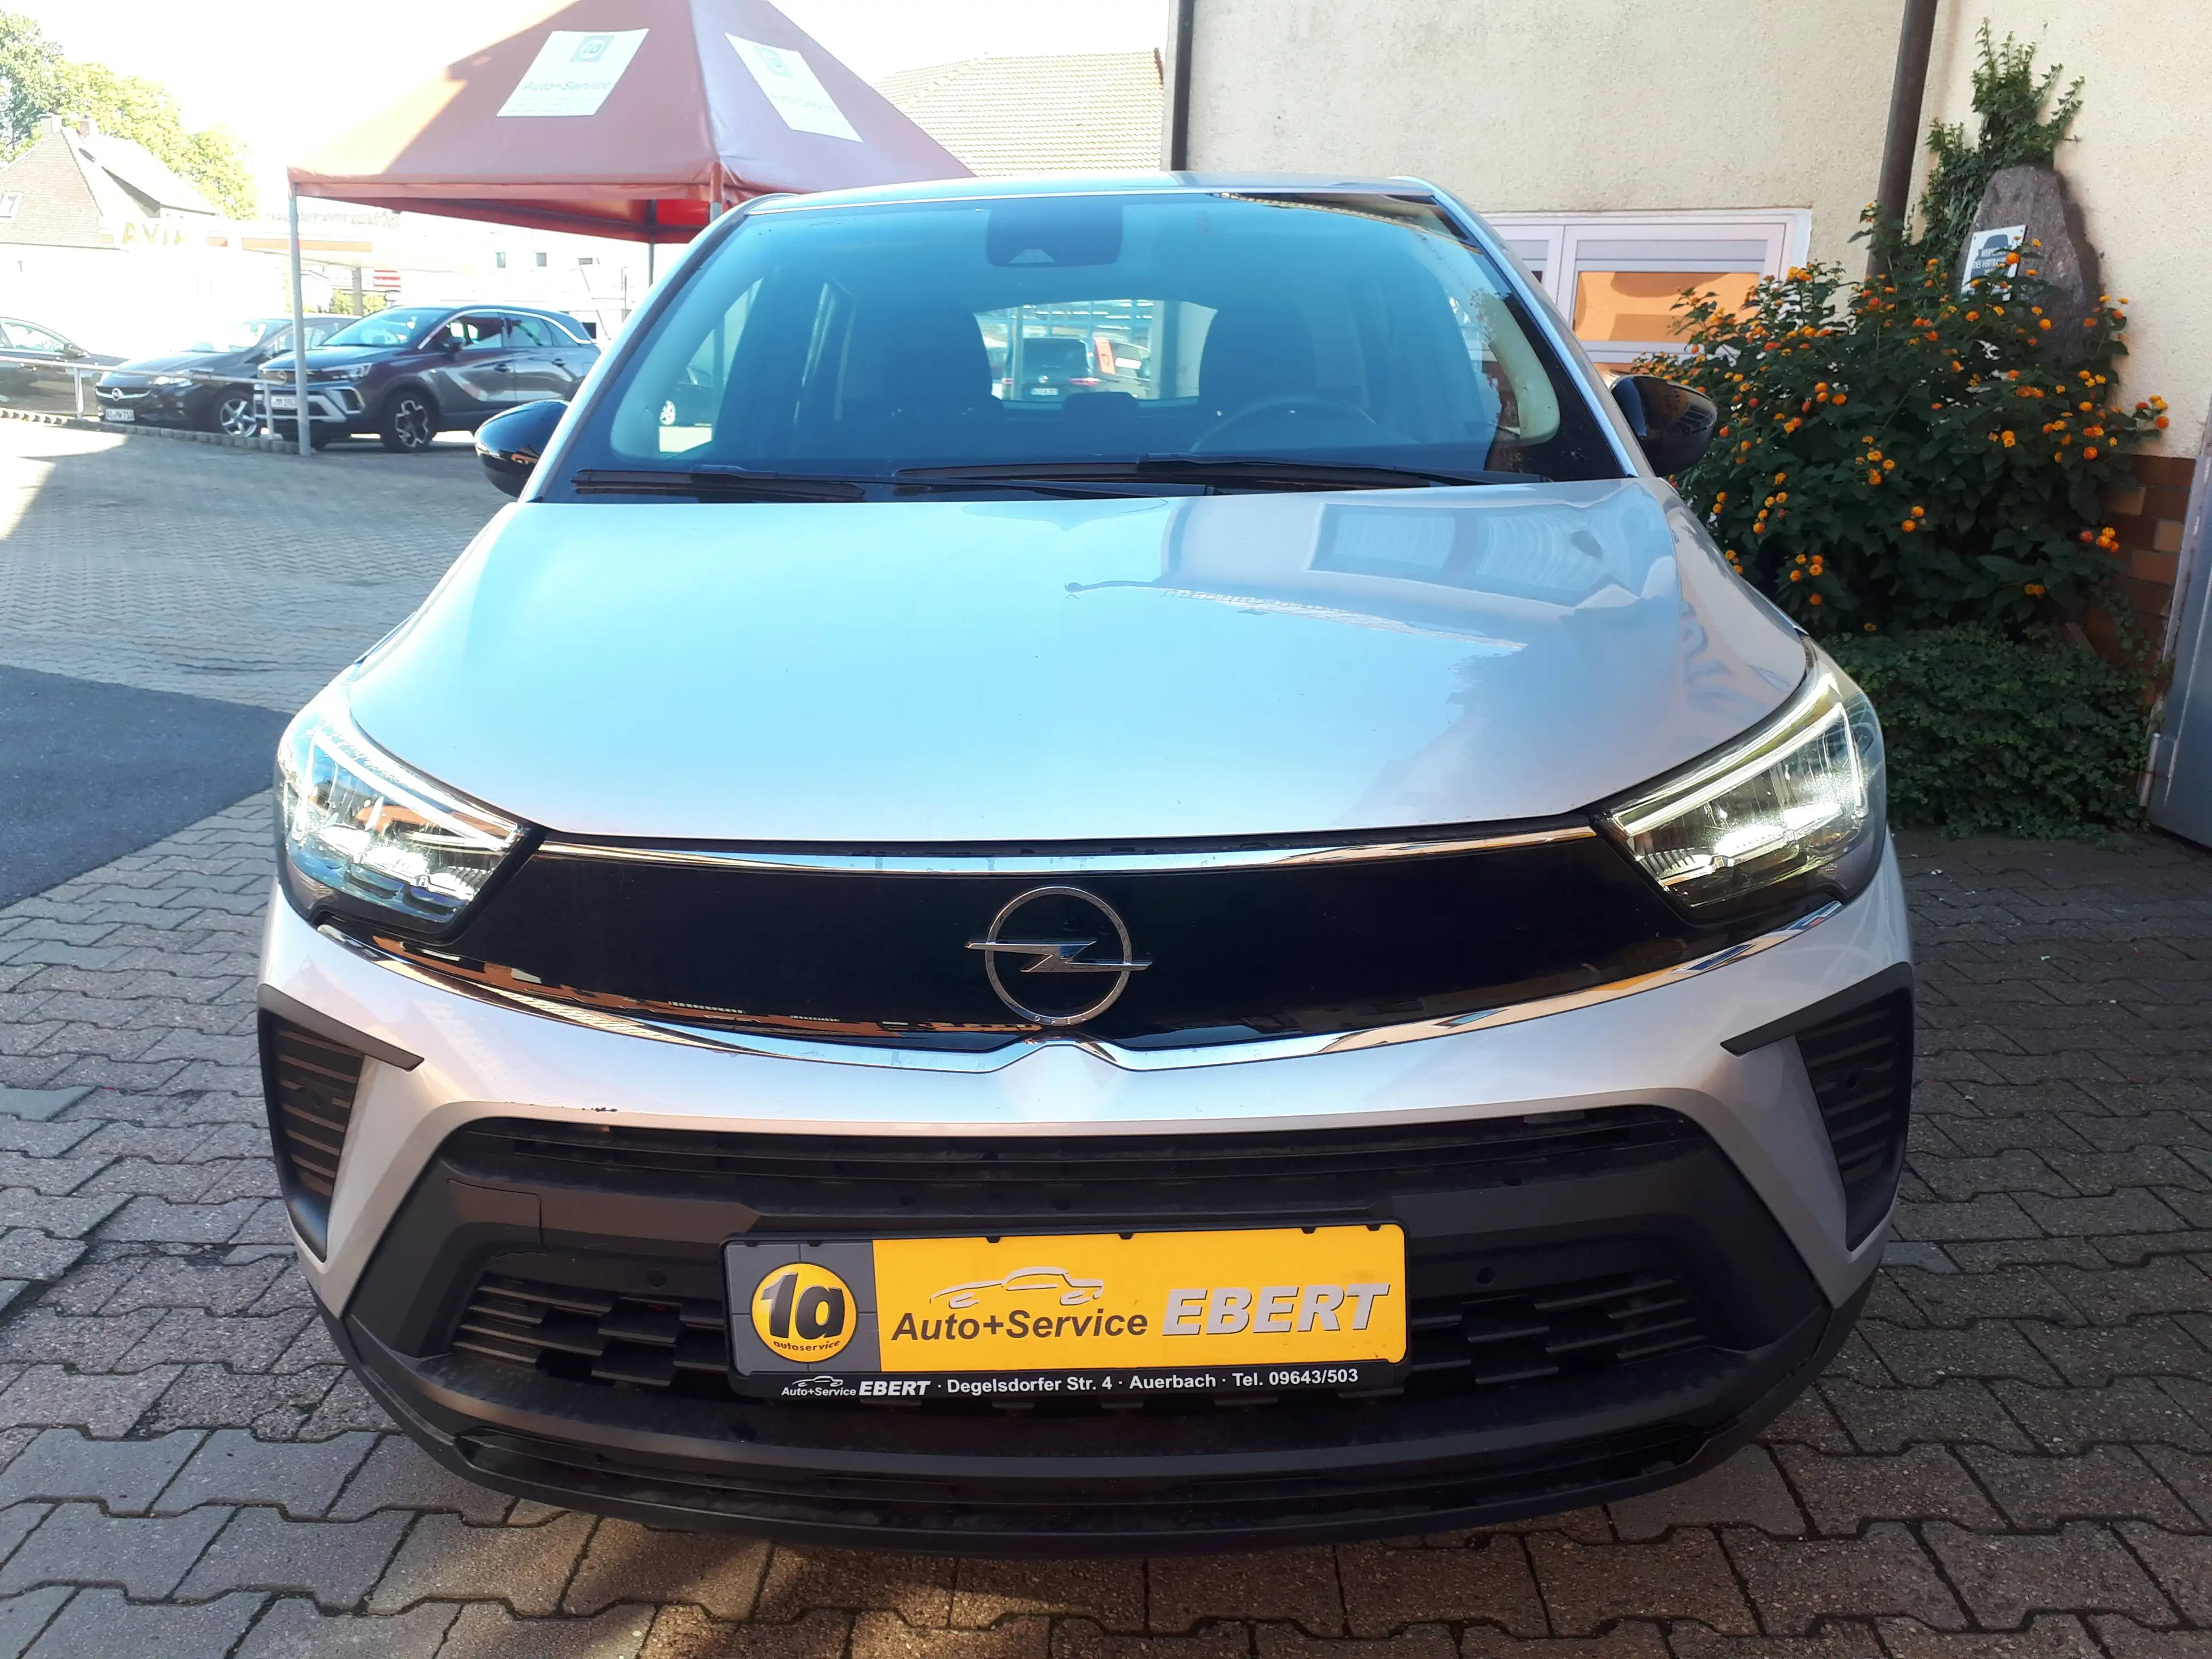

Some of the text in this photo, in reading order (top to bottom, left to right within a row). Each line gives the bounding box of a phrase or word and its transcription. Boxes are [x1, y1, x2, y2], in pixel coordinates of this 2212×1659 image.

[760, 1272, 845, 1340] 1a
[891, 1282, 1391, 1340] Auto+Service EBERT
[773, 1340, 840, 1351] autoservice
[781, 1368, 1359, 1396] Auto+Service EBERT Degelsdorfer Str. 4 Auerbach Tel. 09643/503
